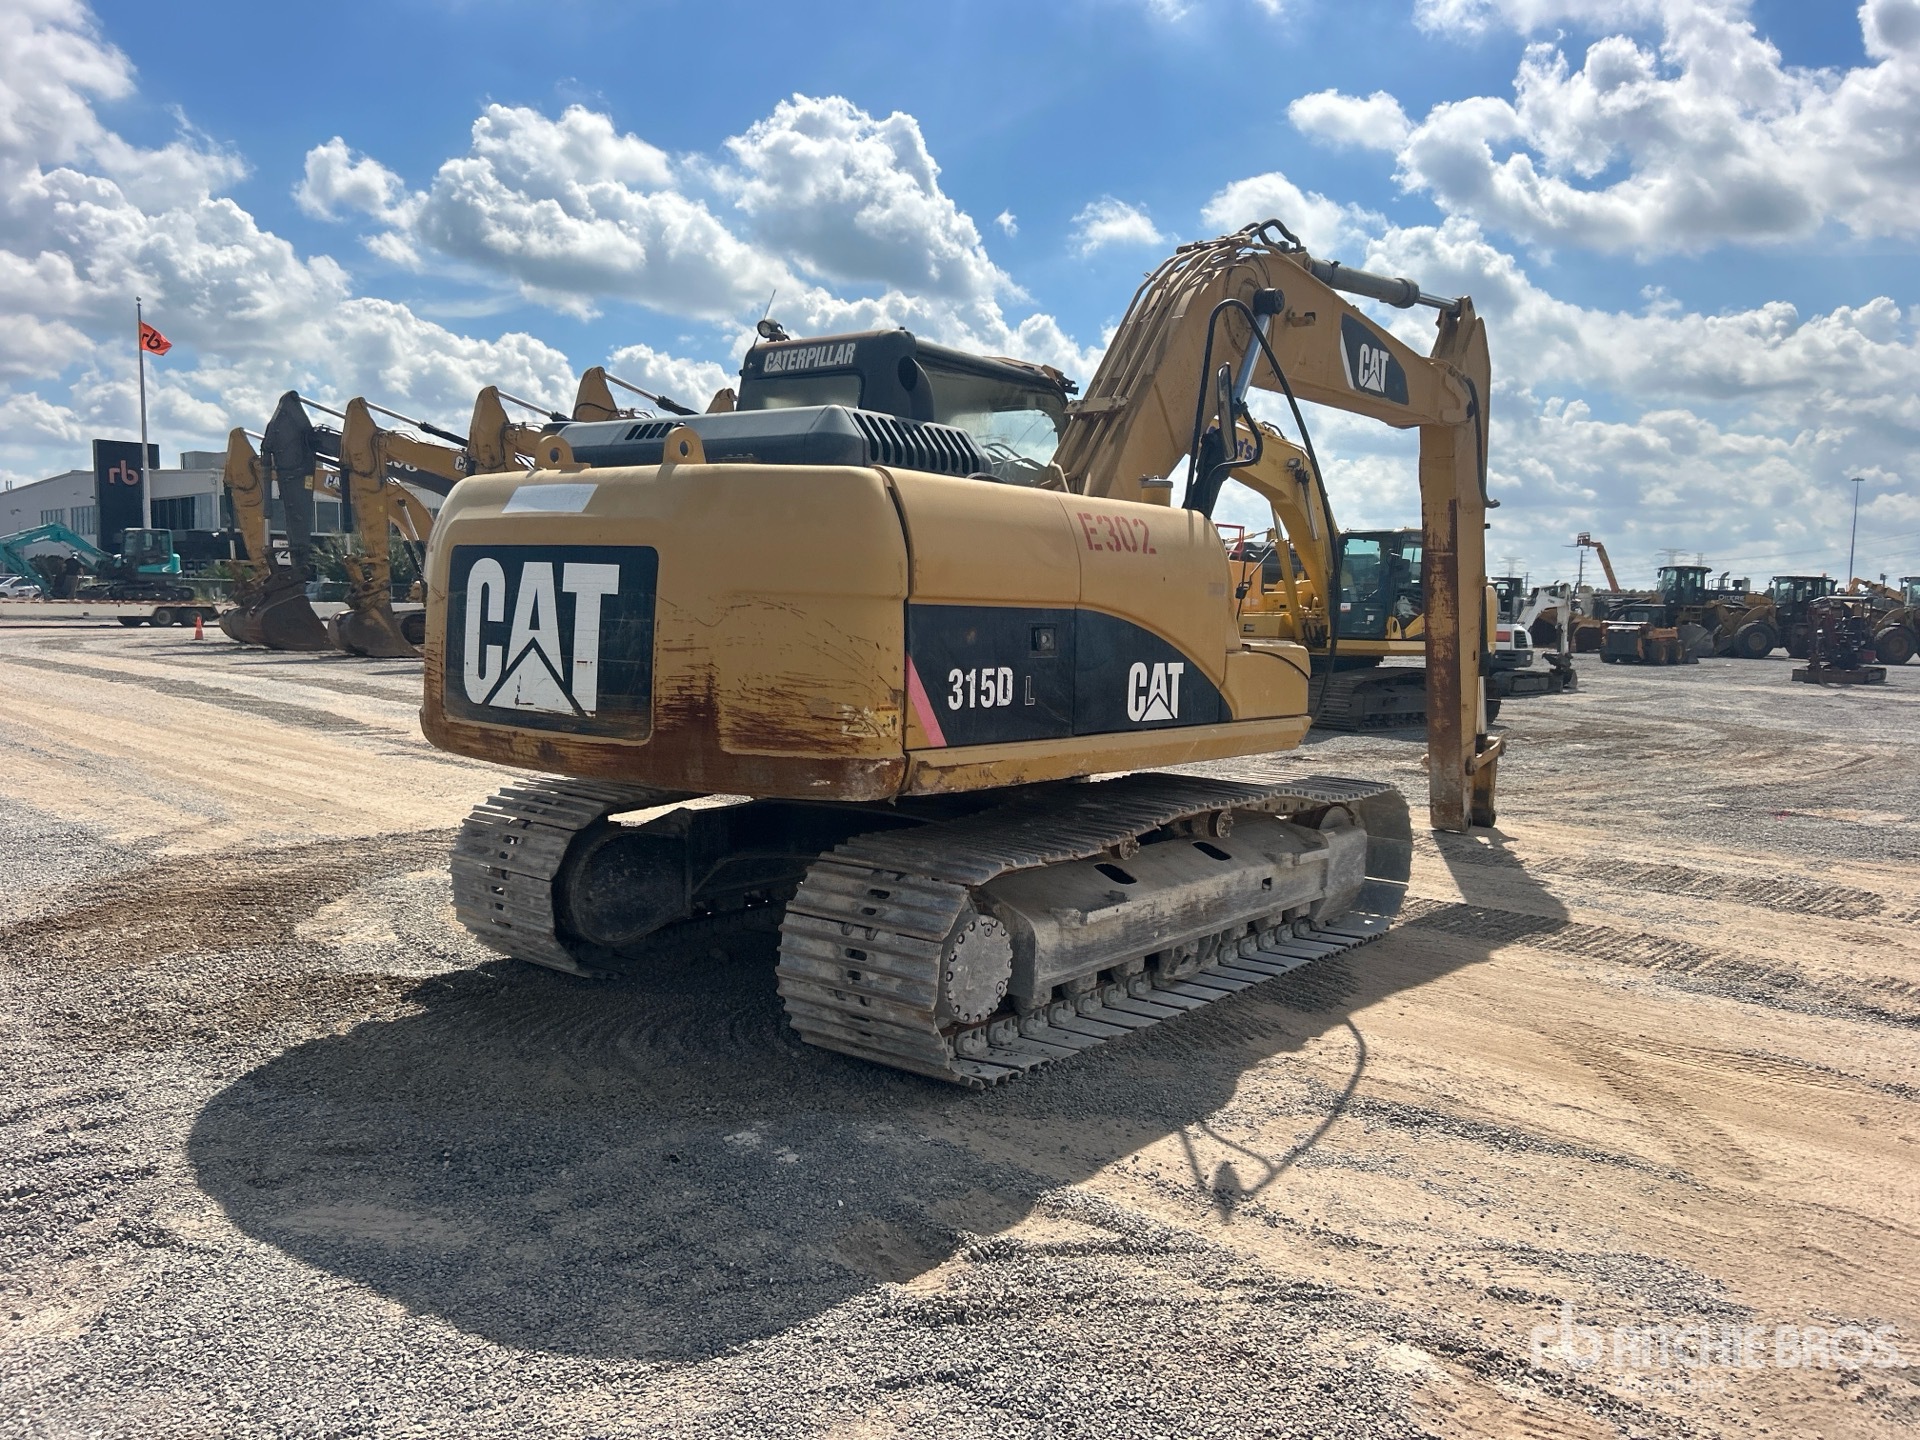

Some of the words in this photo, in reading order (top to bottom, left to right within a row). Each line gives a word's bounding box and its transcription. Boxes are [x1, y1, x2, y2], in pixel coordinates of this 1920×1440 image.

[763, 342, 857, 373] CATERPILLAR
[1358, 343, 1390, 393] CAT
[108, 459, 139, 486] rb
[324, 473, 341, 488] CA
[1077, 512, 1157, 555] E302
[463, 557, 620, 719] CAT
[948, 666, 1014, 711] 315D
[1024, 675, 1036, 706] L
[1127, 661, 1184, 722] CAT
